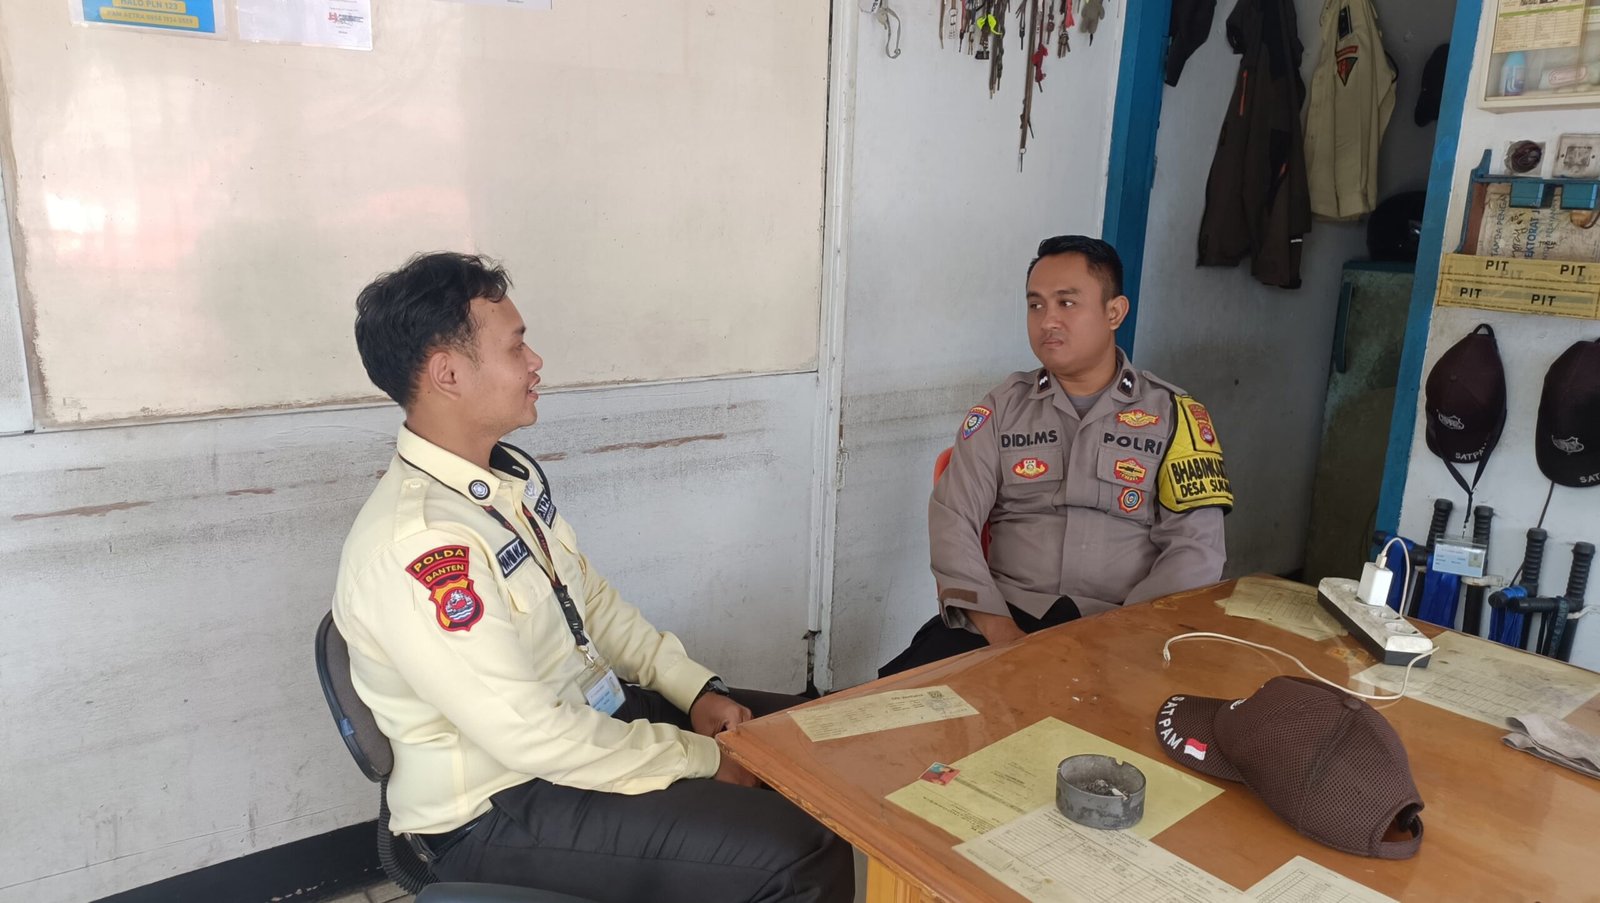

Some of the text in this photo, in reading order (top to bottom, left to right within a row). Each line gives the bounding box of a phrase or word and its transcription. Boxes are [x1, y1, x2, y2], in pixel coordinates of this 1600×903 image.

[165, 2, 178, 10] 123
[1485, 260, 1586, 277] PIT PIT
[1460, 287, 1556, 307] PIT PIT
[1001, 430, 1058, 448] DIDI.MS
[1103, 432, 1163, 455] POLRI
[1455, 442, 1487, 461] SATPA
[1179, 481, 1208, 498] DESA
[413, 549, 465, 573] POLDA
[425, 564, 465, 583] BANTEN
[1158, 695, 1185, 750] SATPAM
